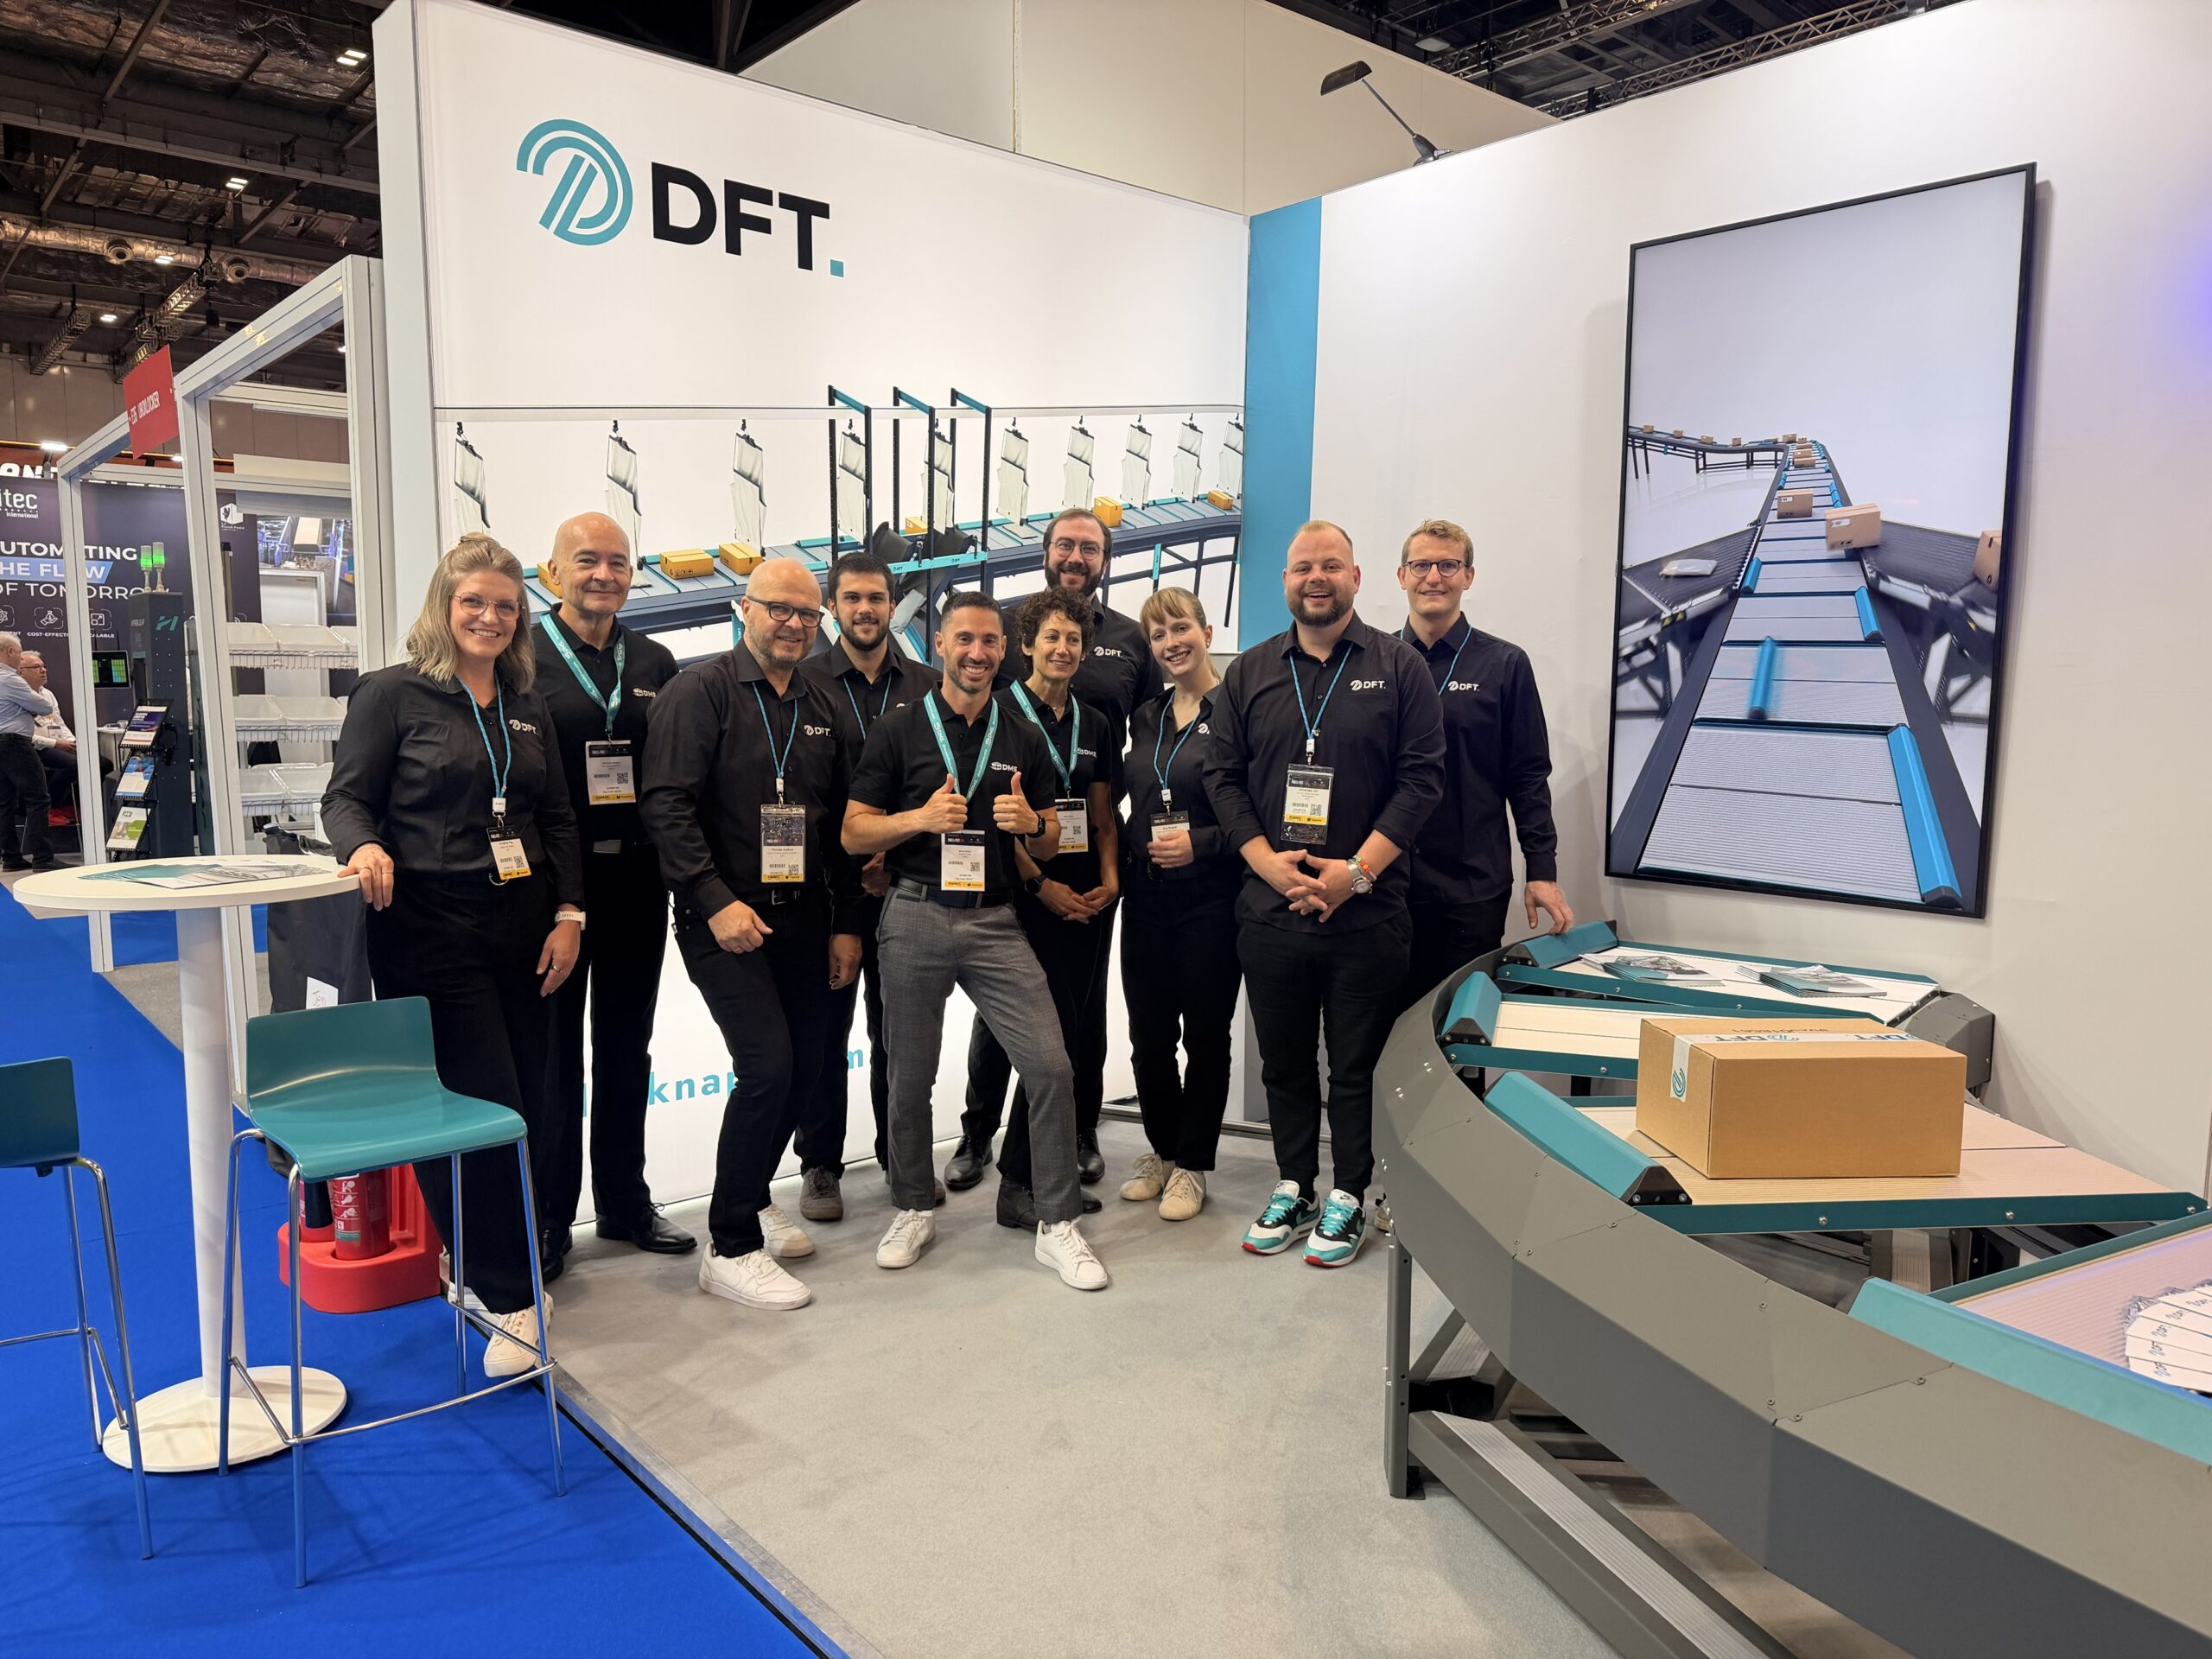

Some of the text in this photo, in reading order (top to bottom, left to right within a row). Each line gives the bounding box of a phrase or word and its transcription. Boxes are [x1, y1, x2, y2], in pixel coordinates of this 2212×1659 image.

[0, 541, 137, 561] UTOMTING
[0, 562, 105, 579] HE FLW
[0, 582, 18, 595] F
[1001, 763, 1018, 772] DMS
